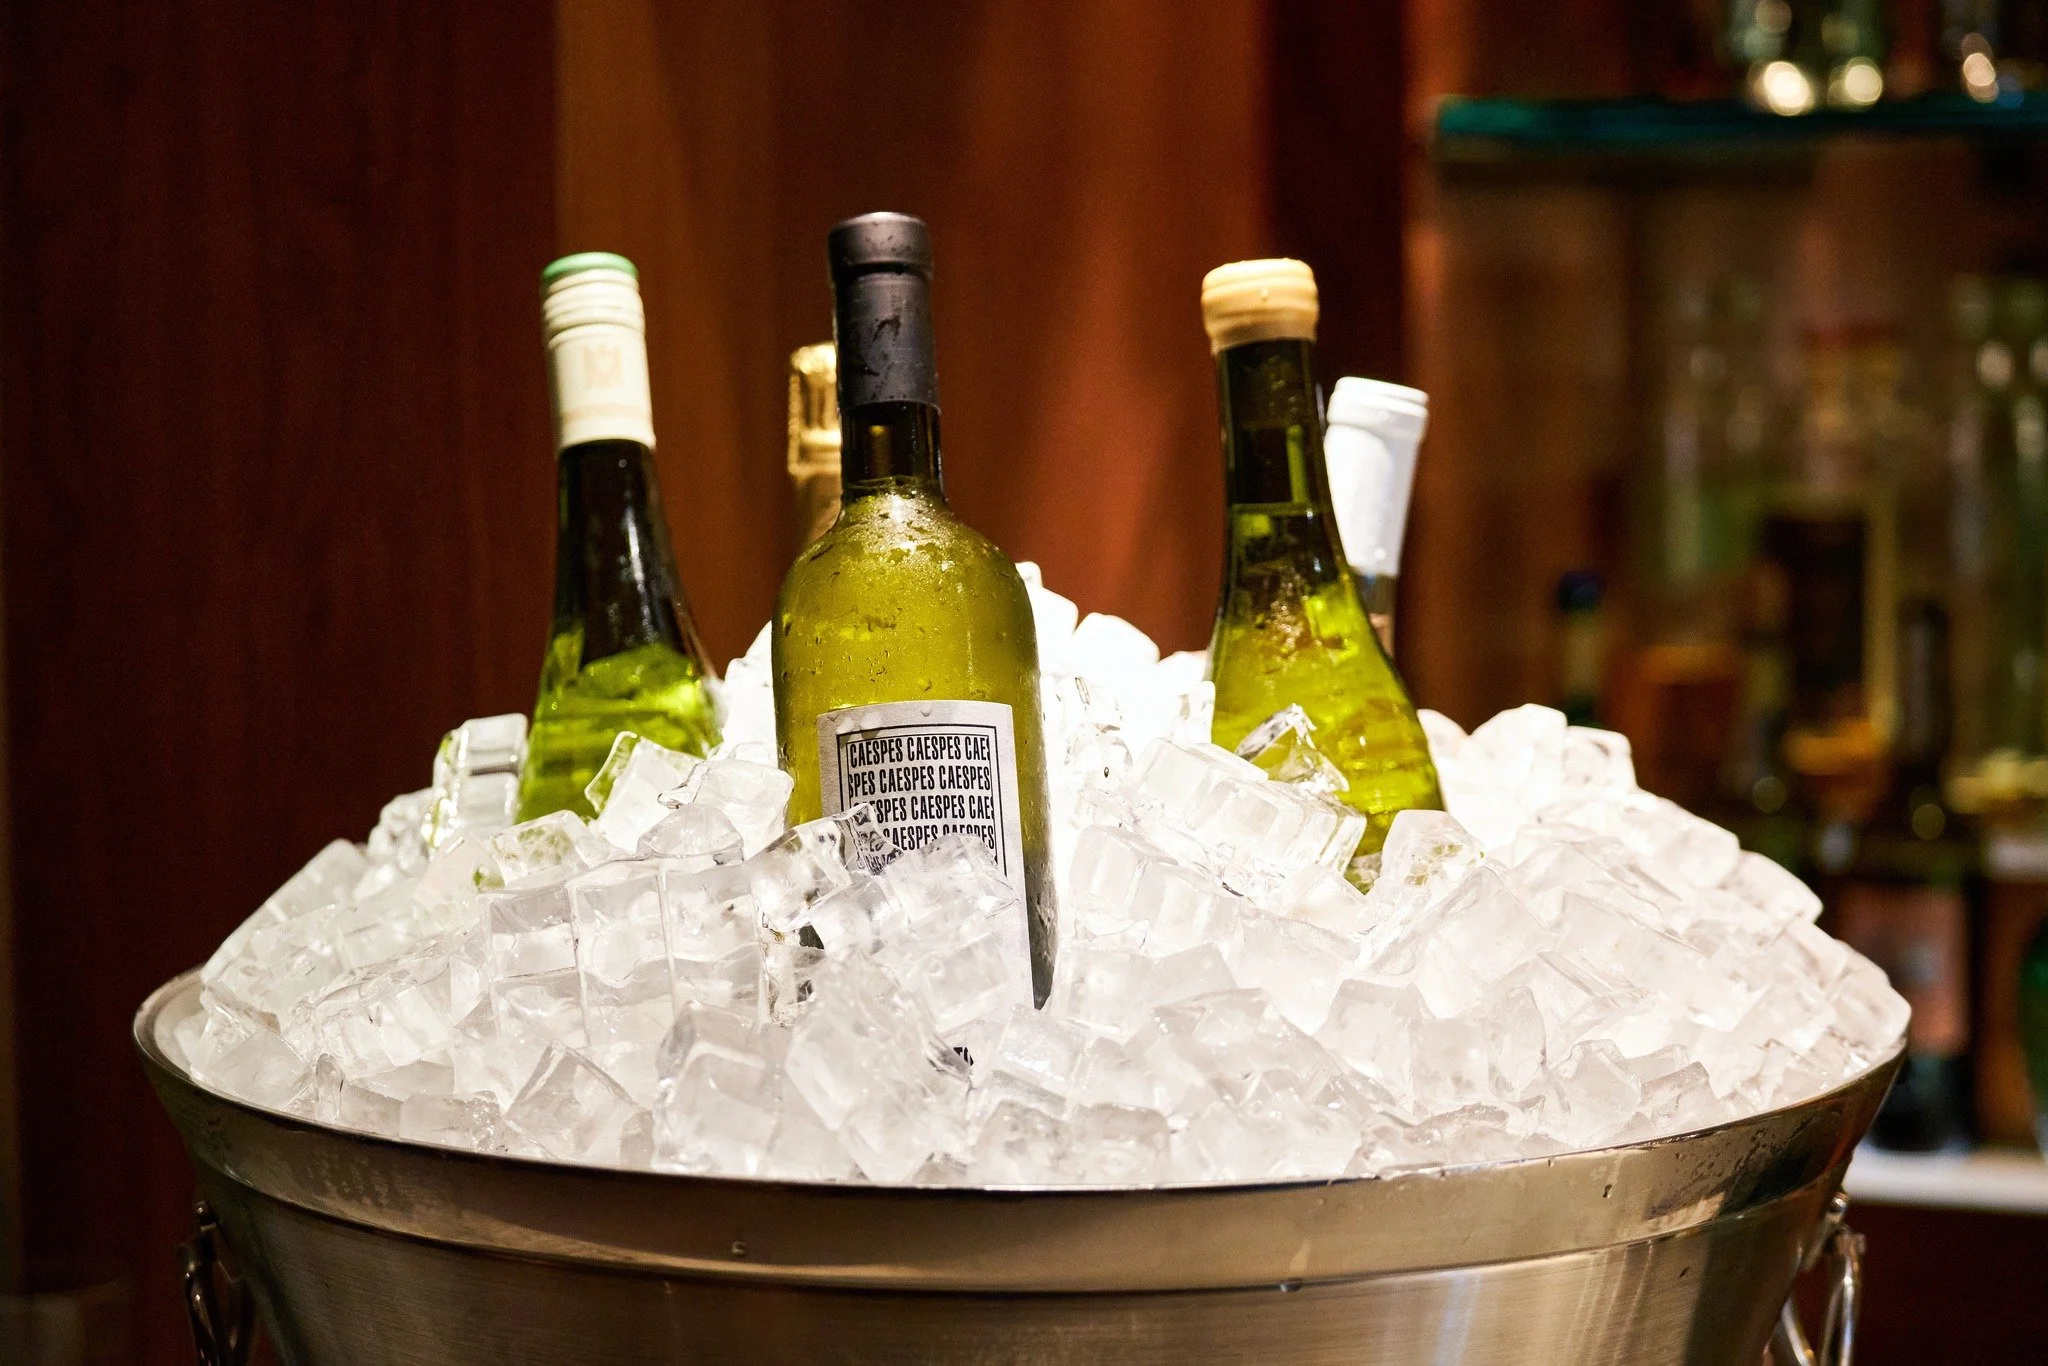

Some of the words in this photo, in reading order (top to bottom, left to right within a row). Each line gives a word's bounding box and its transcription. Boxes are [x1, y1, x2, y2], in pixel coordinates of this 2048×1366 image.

[850, 738, 904, 768] CAESPES
[907, 736, 961, 761] CAESPES
[879, 765, 935, 794] CAESPES
[939, 765, 991, 791] CAESPES
[854, 795, 907, 823] SPES
[911, 795, 965, 820] CAESPES
